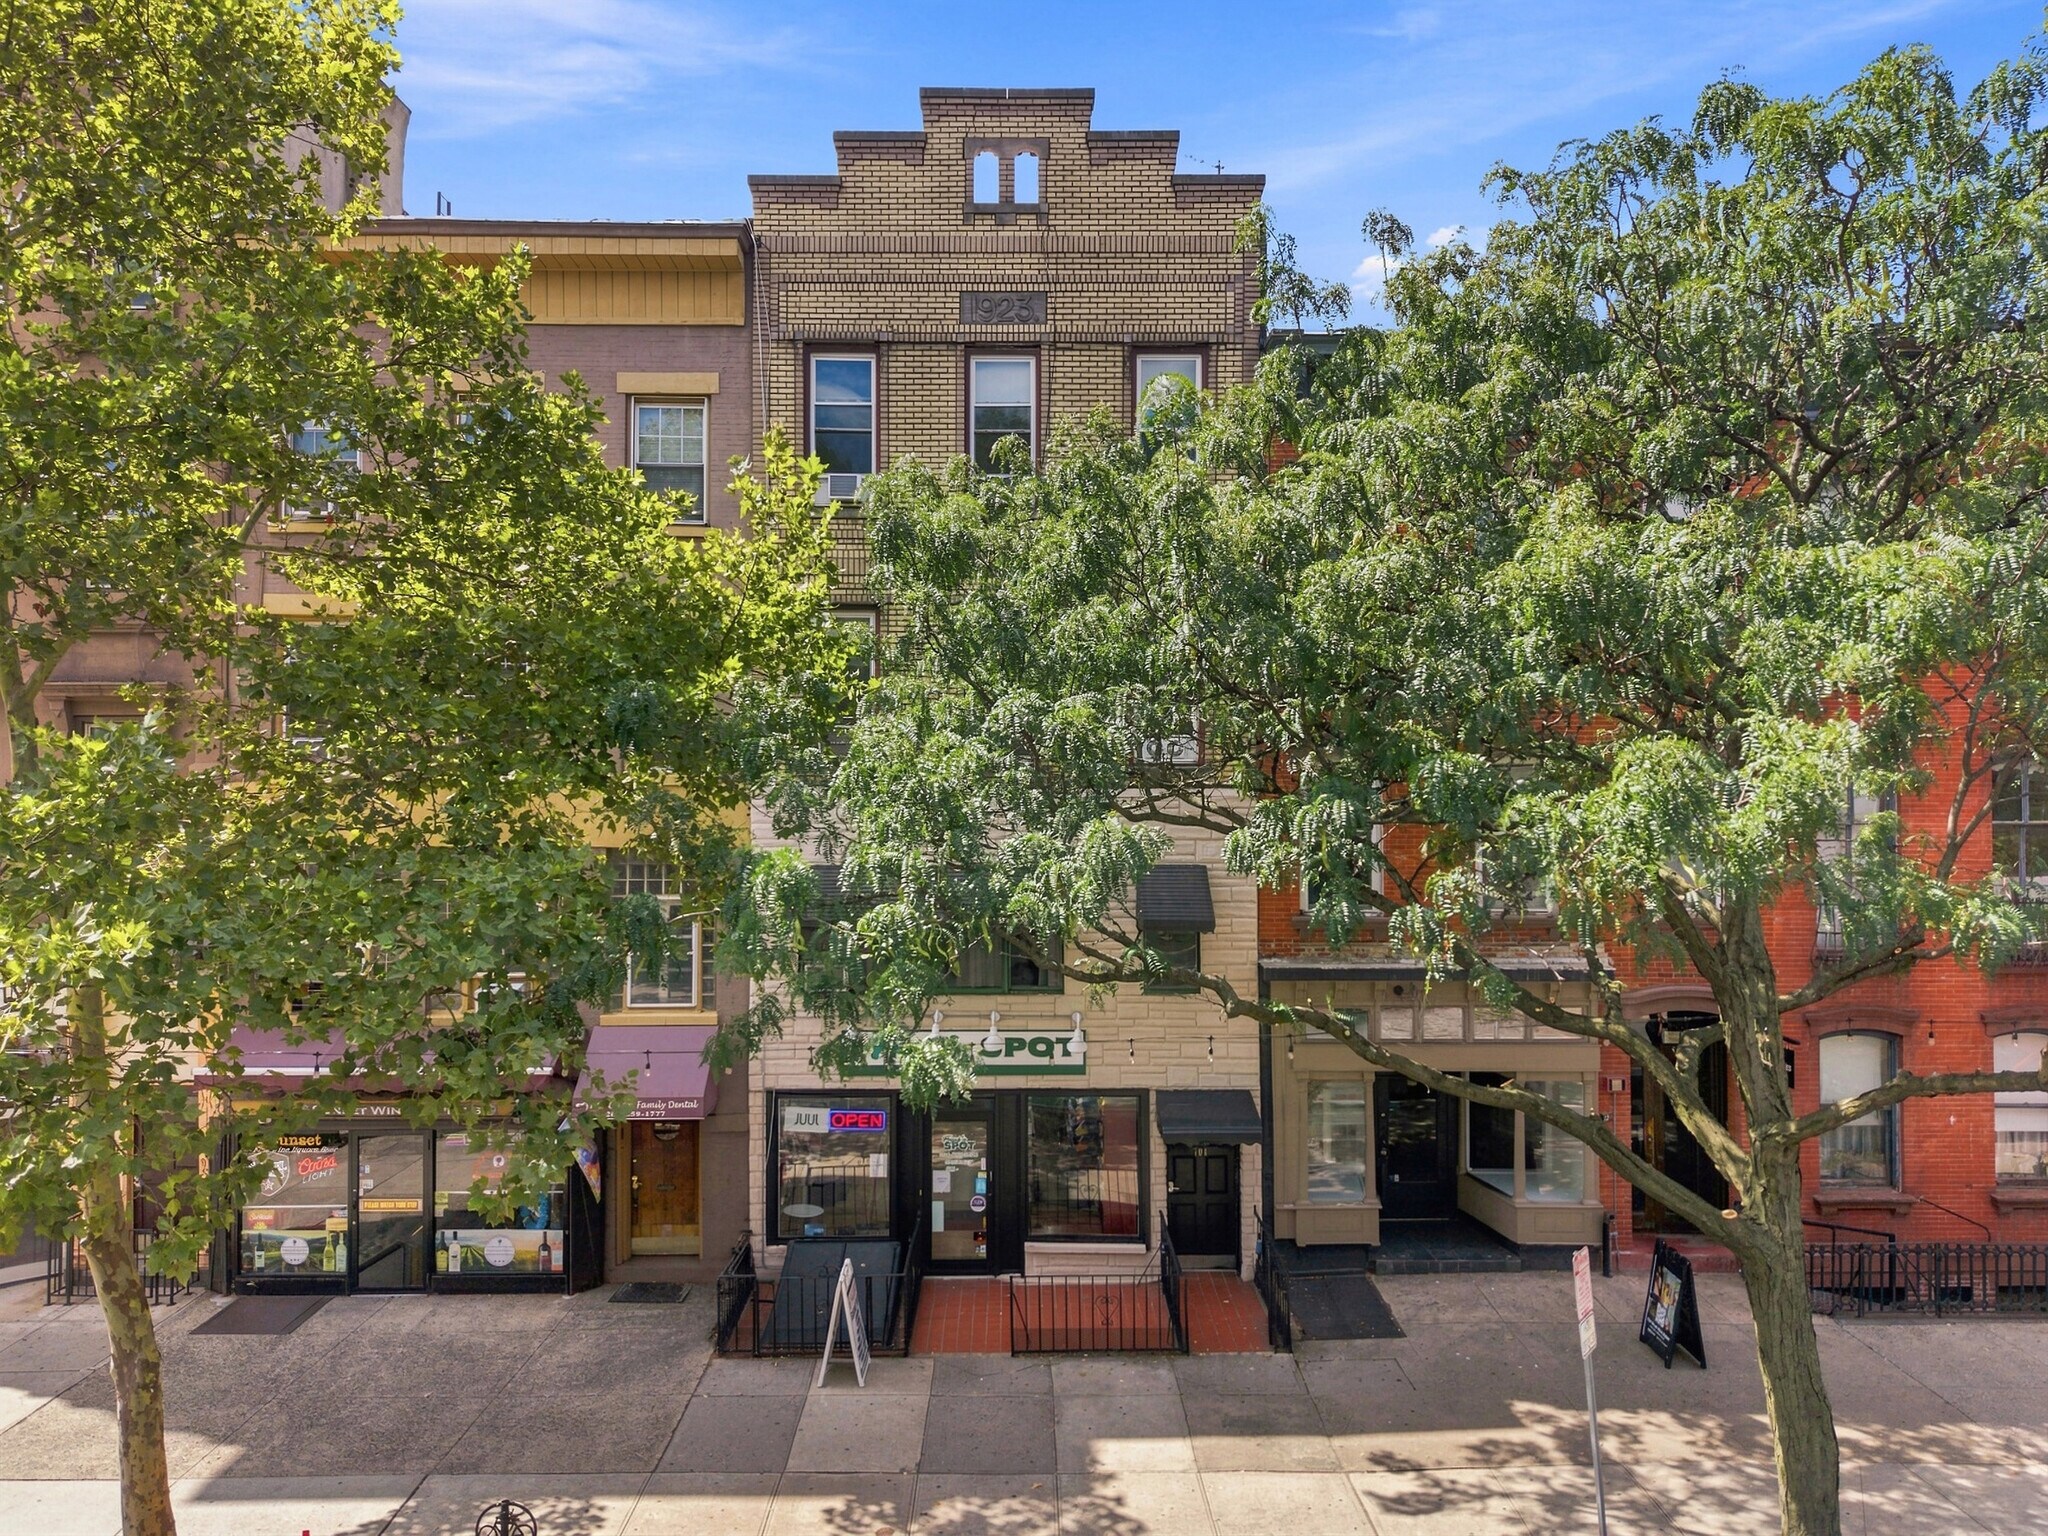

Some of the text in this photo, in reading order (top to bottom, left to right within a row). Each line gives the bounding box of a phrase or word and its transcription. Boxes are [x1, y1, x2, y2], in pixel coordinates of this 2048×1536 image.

[370, 1105, 402, 1115] WIN
[636, 1100, 665, 1111] Family
[667, 1099, 699, 1109] Dental
[794, 1112, 820, 1126] JUUL
[831, 1113, 883, 1128] OPEN
[277, 1134, 322, 1147] unset
[944, 1140, 977, 1151] SPOT
[302, 1168, 335, 1184] LIGHT
